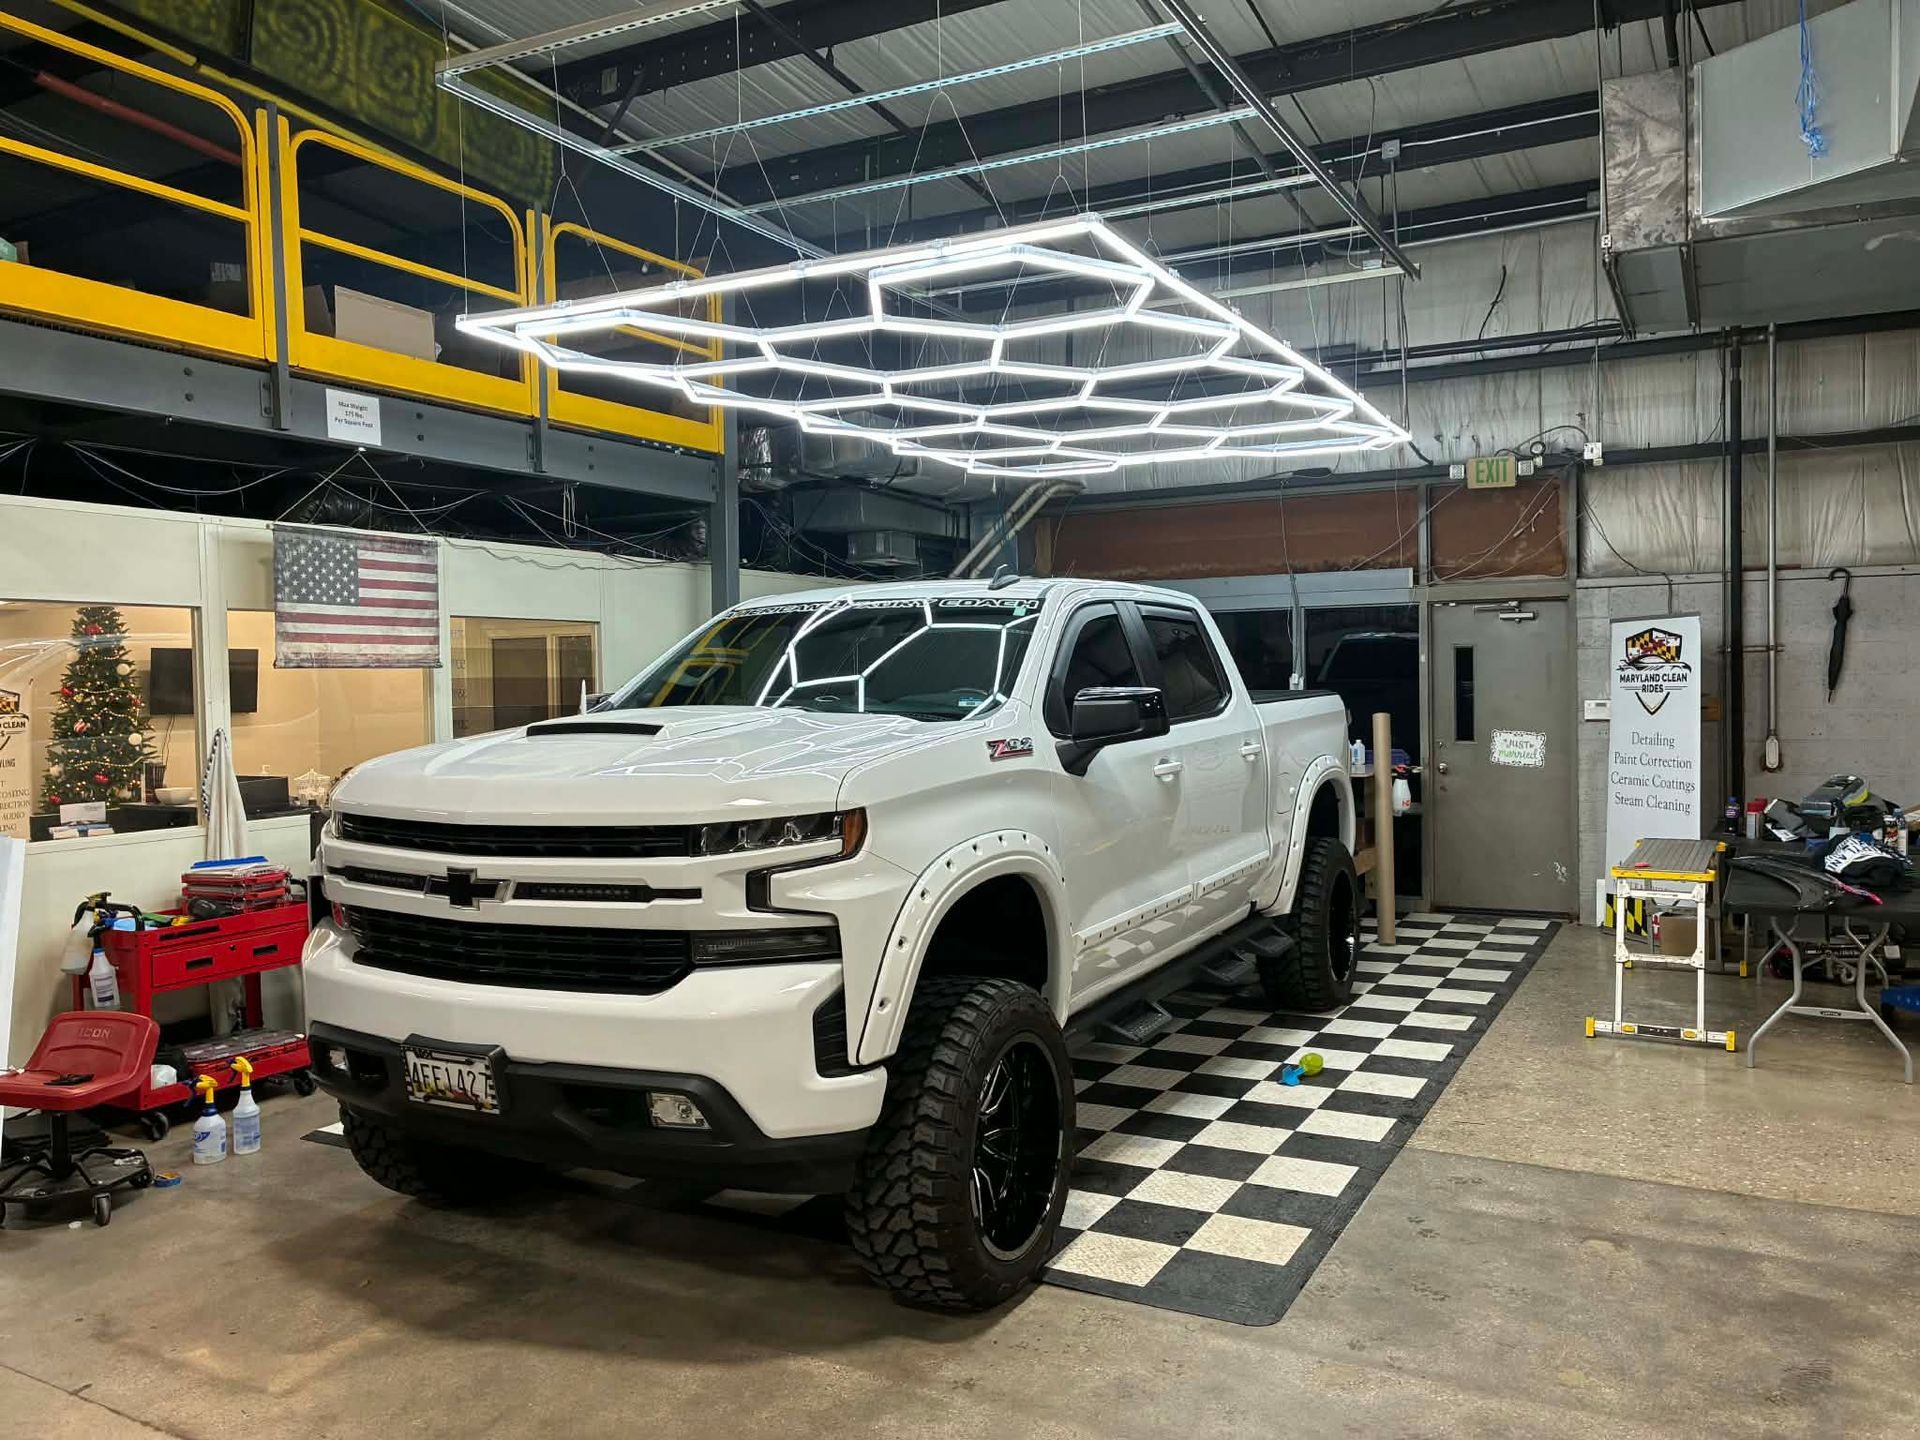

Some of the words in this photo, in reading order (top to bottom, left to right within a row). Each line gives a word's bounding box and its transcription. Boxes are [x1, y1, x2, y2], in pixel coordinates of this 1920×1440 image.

[1475, 458, 1509, 484] EXIT
[938, 599, 1039, 610] COACH
[1620, 673, 1660, 684] MARYLAND
[1661, 672, 1688, 683] CLEAN
[1641, 684, 1664, 693] RIDES
[2, 721, 26, 729] CLEAN
[1506, 739, 1529, 749] JUST
[1631, 731, 1675, 750] Detailing
[1614, 751, 1638, 766] Paint
[1639, 752, 1693, 770] Correction
[1610, 770, 1650, 787] Ceramic
[1651, 774, 1696, 794] Coatings
[1614, 791, 1644, 807] Steam
[1646, 794, 1691, 816] Cleaning
[79, 1026, 112, 1040] ICON
